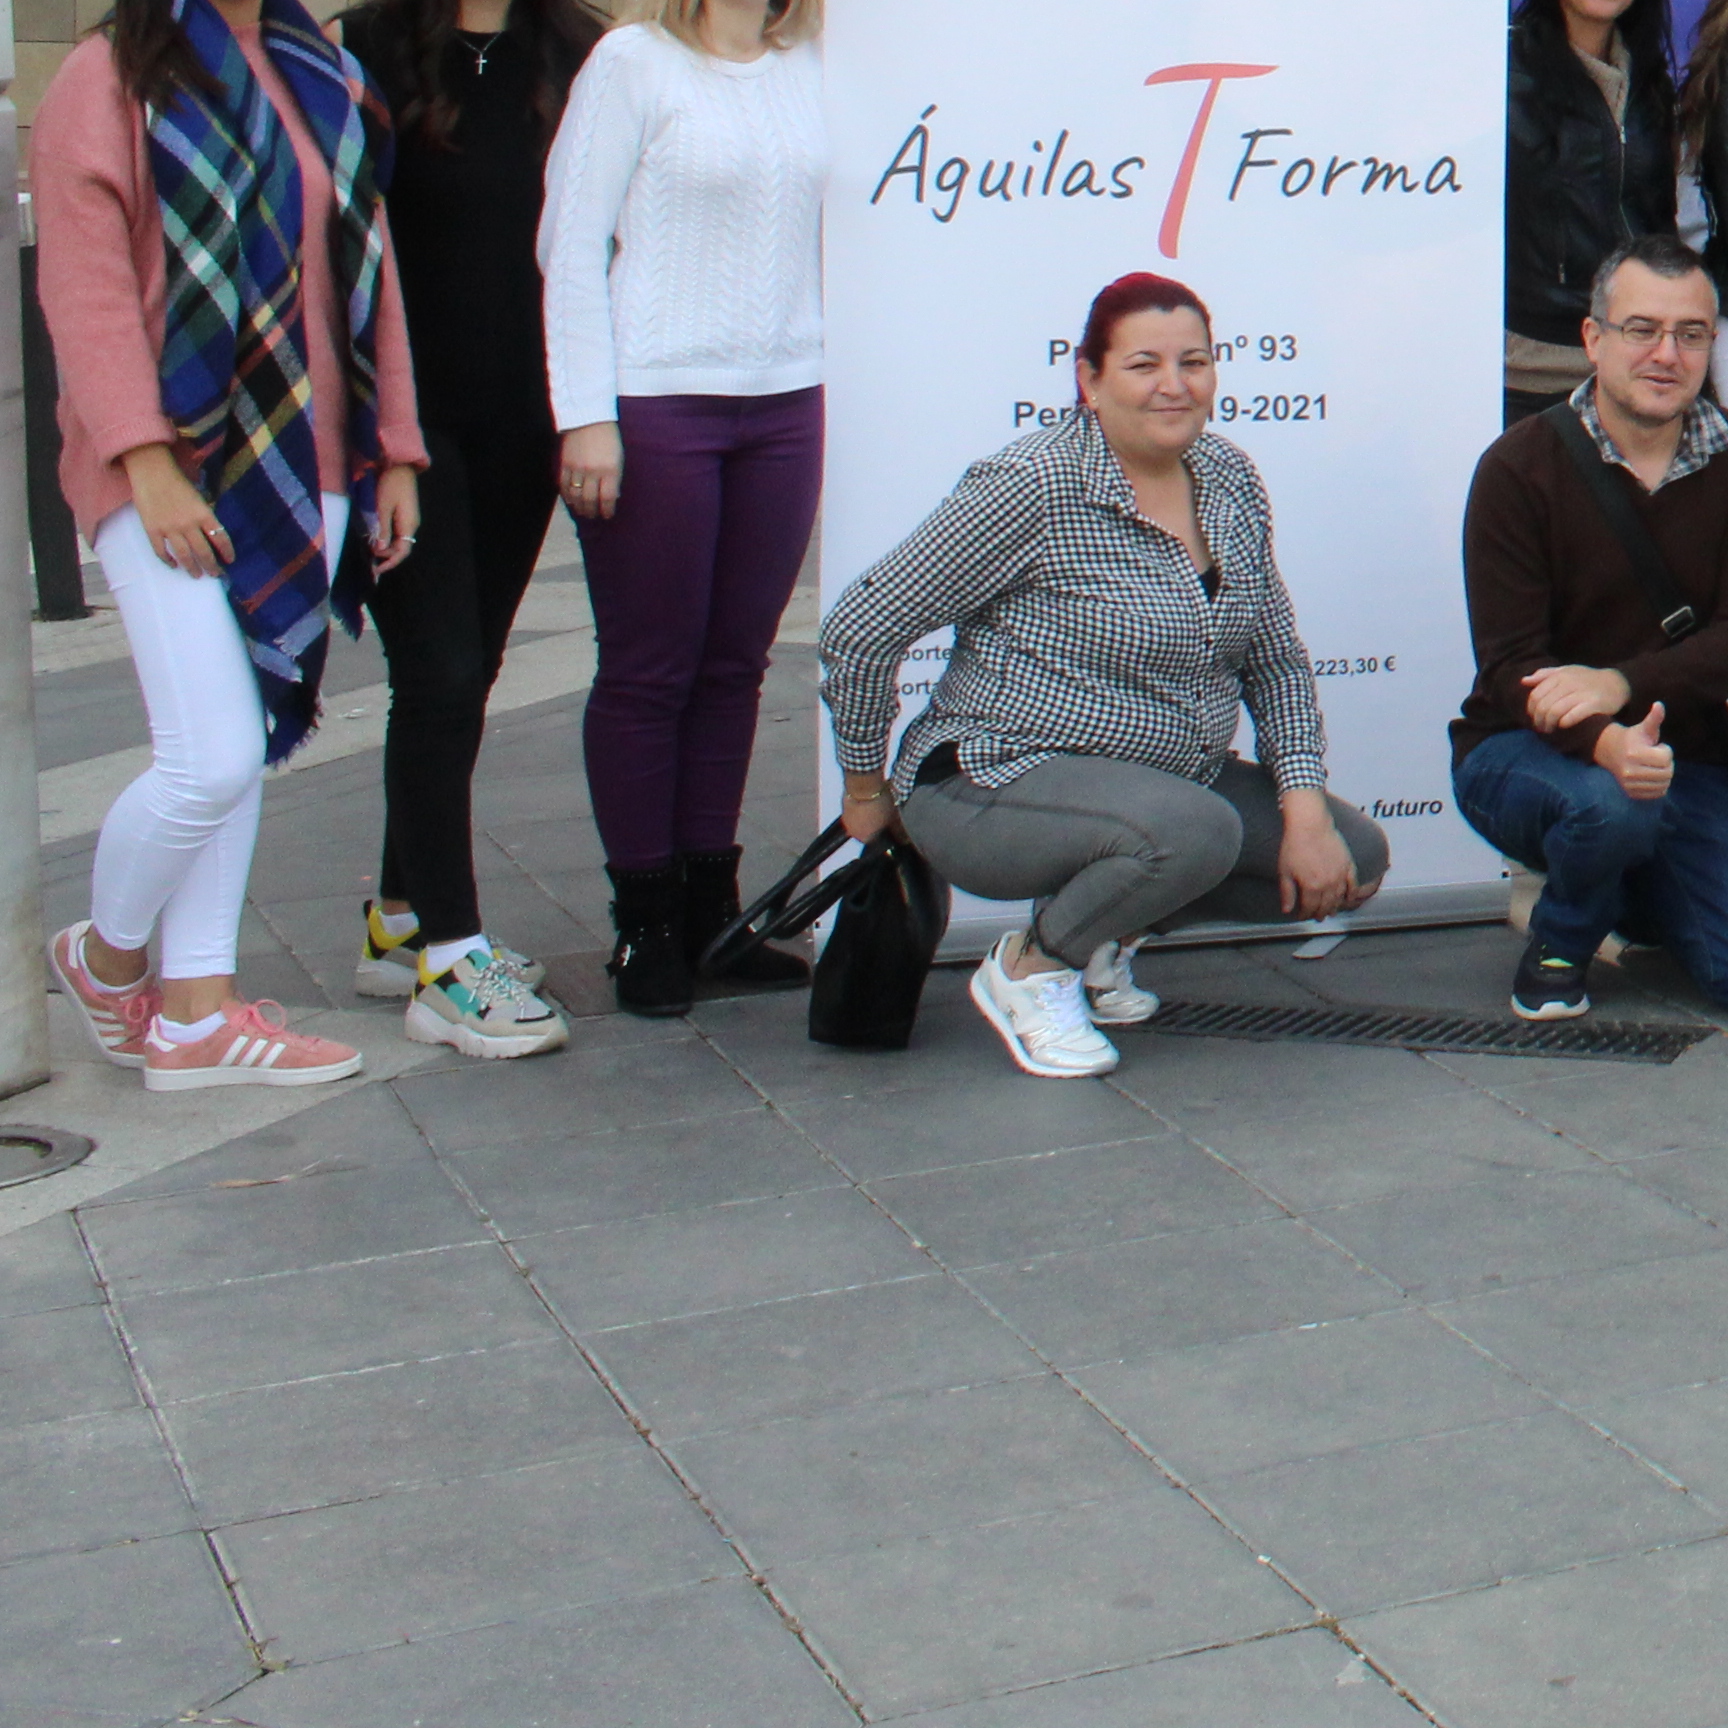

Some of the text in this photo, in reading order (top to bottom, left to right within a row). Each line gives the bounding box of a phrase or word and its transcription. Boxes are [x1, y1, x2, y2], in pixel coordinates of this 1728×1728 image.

[871, 62, 1463, 260] Águilas T Forma
[1259, 335, 1298, 362] 93
[1014, 401, 1072, 428] Per
[1315, 655, 1397, 677] 223,30 €
[1373, 799, 1443, 819] futuro
